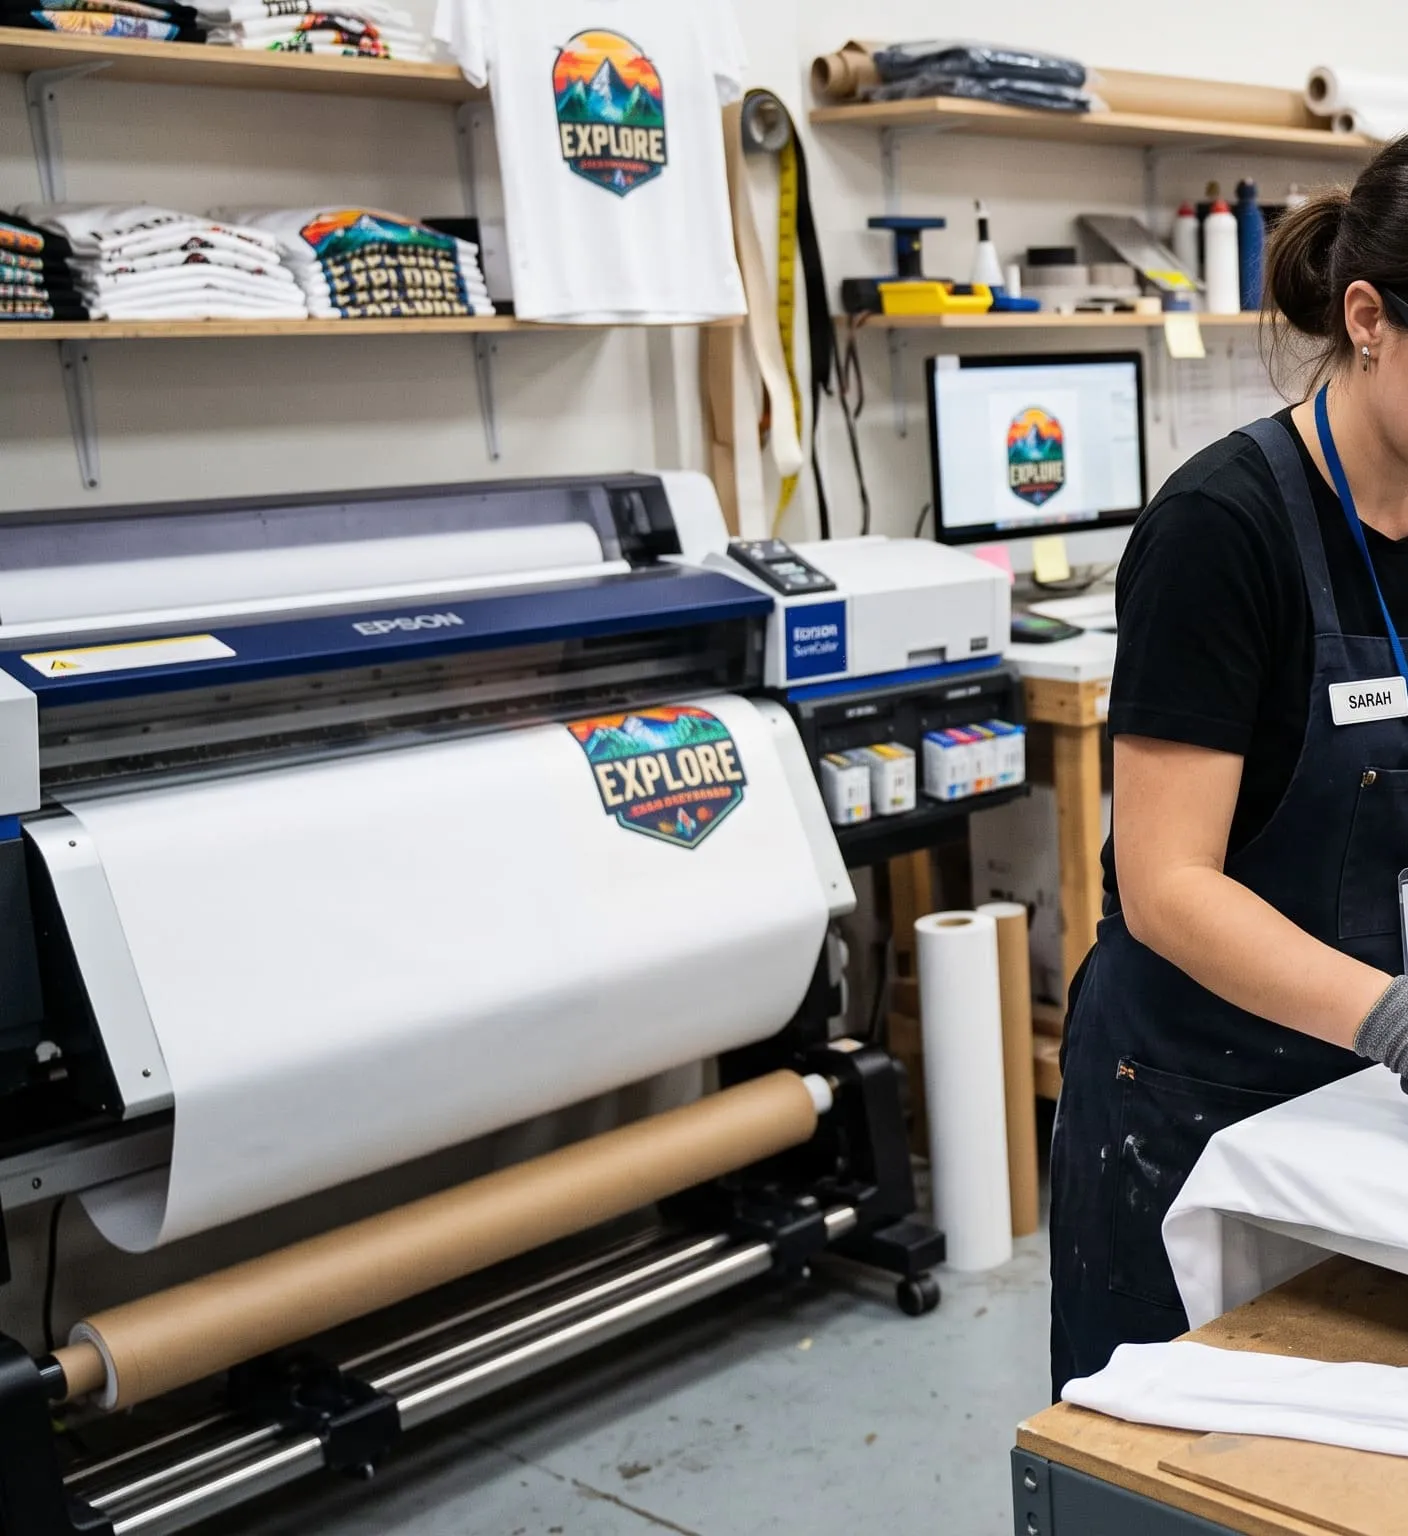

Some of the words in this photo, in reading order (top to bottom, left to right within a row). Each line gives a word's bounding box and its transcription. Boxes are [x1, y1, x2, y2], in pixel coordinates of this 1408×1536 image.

[560, 122, 666, 163] EXPLORE
[351, 612, 465, 636] EPSON
[1348, 690, 1392, 709] SARAH
[594, 739, 743, 807] EXPLORE
